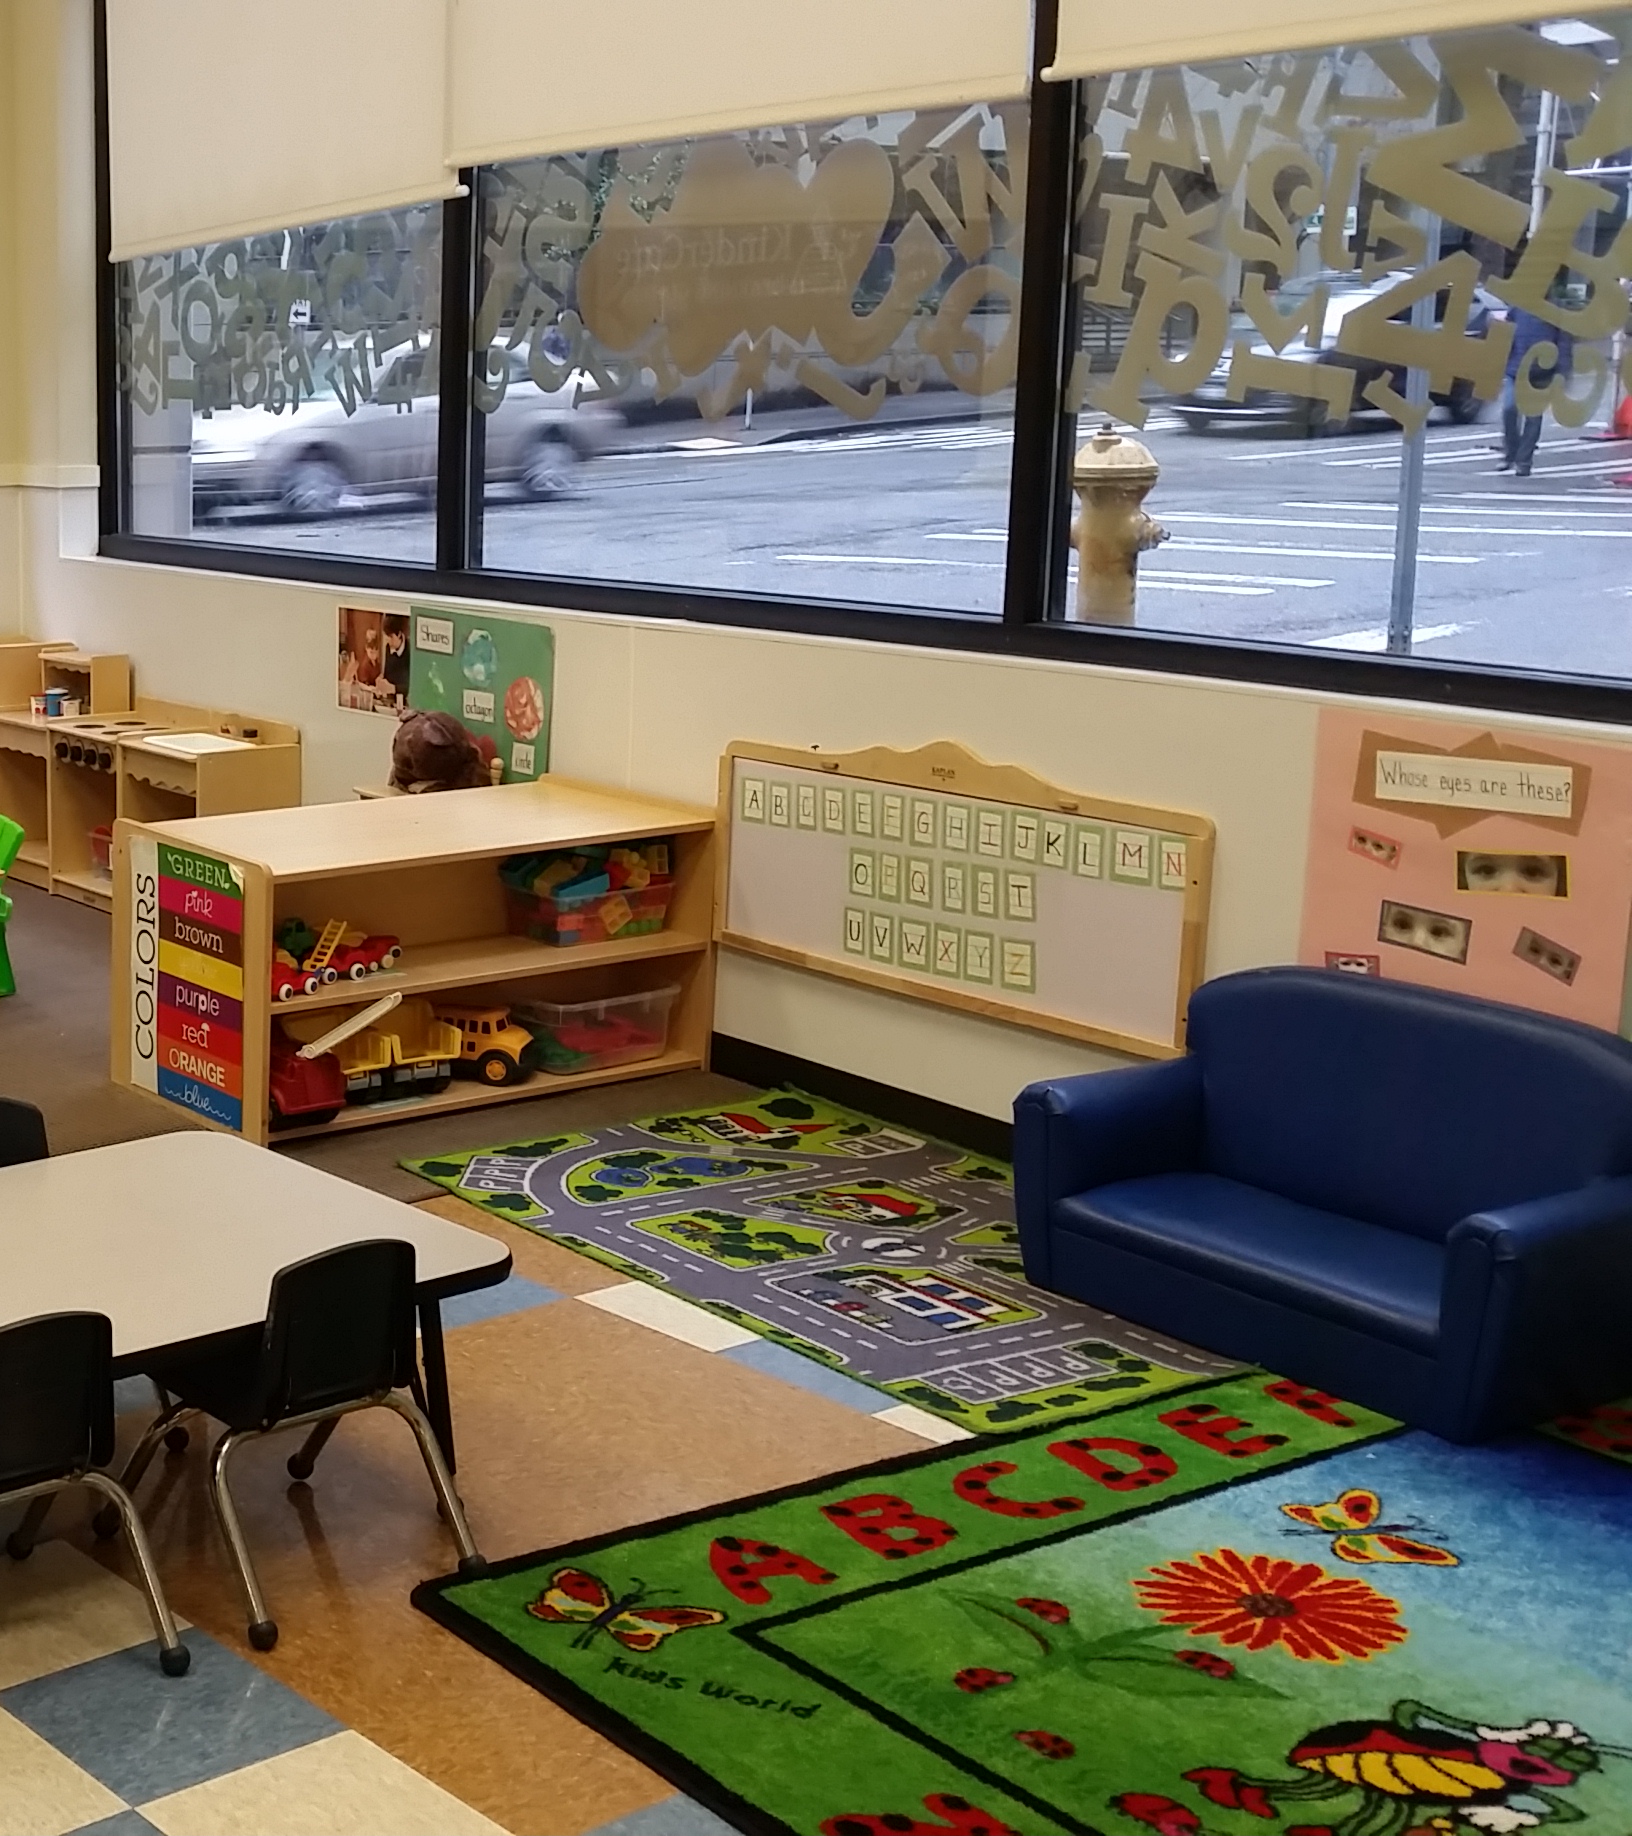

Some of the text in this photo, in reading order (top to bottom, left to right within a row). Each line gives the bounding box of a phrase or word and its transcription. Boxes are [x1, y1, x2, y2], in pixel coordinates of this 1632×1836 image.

[465, 696, 494, 722] octagon
[1379, 758, 1571, 803] Whose eyes are these?
[748, 789, 1182, 875] A B C D E F G H I J K L M N
[169, 853, 227, 888] GREEN
[855, 864, 868, 885] O
[911, 871, 926, 894] Q
[947, 876, 958, 898] R
[979, 882, 991, 905] S
[1012, 885, 1028, 907] T
[185, 890, 213, 919] pink
[174, 916, 223, 954] brown
[849, 920, 1025, 976] U V W X Y Z
[136, 873, 155, 1060] COLORS
[176, 984, 219, 1016] purple
[182, 1022, 210, 1048] red
[169, 1048, 225, 1088] ORANGE
[710, 1536, 839, 1605] A
[819, 1494, 957, 1560] B
[953, 1461, 1085, 1519] C
[1046, 1437, 1178, 1491] D
[1157, 1404, 1290, 1458] E
[603, 1656, 822, 1719] Kids World
